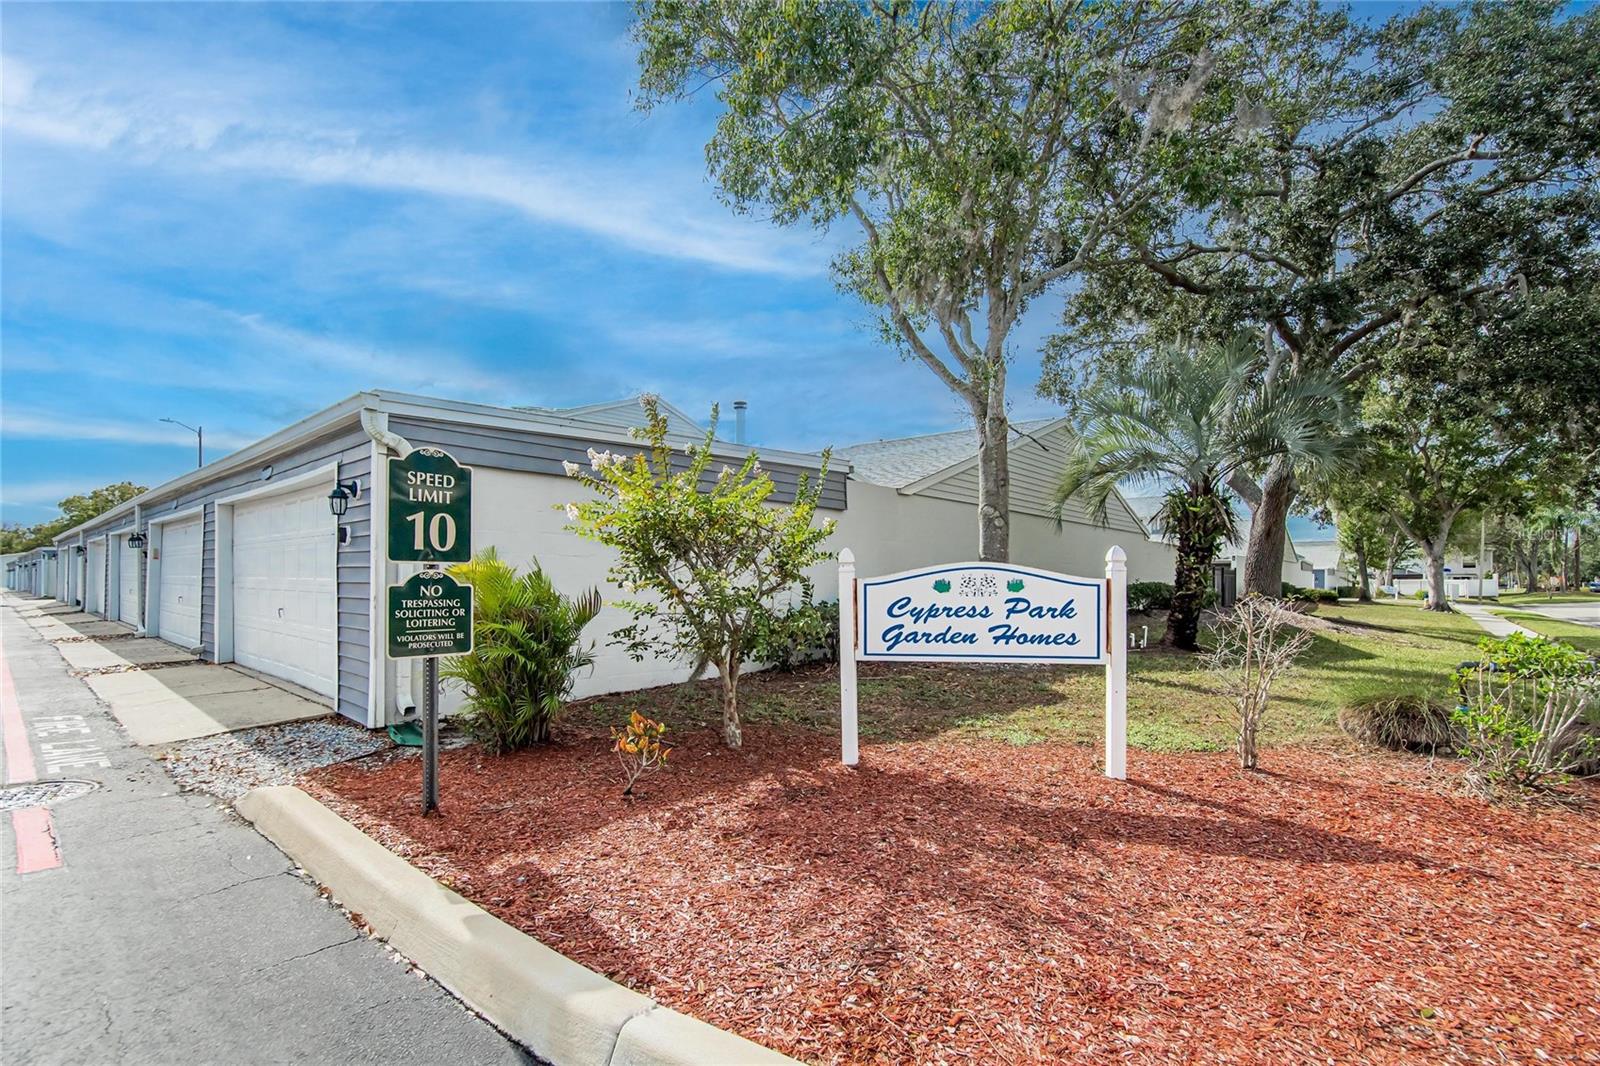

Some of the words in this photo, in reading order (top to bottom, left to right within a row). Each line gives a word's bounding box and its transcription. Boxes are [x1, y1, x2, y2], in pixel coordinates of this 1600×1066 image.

[407, 471, 455, 488] SPEED
[409, 487, 453, 504] LIMIT
[406, 511, 457, 552] 10
[420, 585, 442, 597] NO
[401, 598, 461, 609] TRESPASSING
[395, 608, 449, 619] SOLICITING
[452, 608, 466, 617] OR
[886, 596, 993, 624] Cypress
[1004, 597, 1078, 620] Park
[406, 617, 456, 628] LOITERING
[396, 634, 437, 643] VIOLATORS
[437, 633, 454, 641] WILL
[456, 632, 464, 640] BE
[881, 624, 979, 652] Garden
[987, 624, 1081, 646] Homes
[408, 640, 454, 649] PROSECUTED
